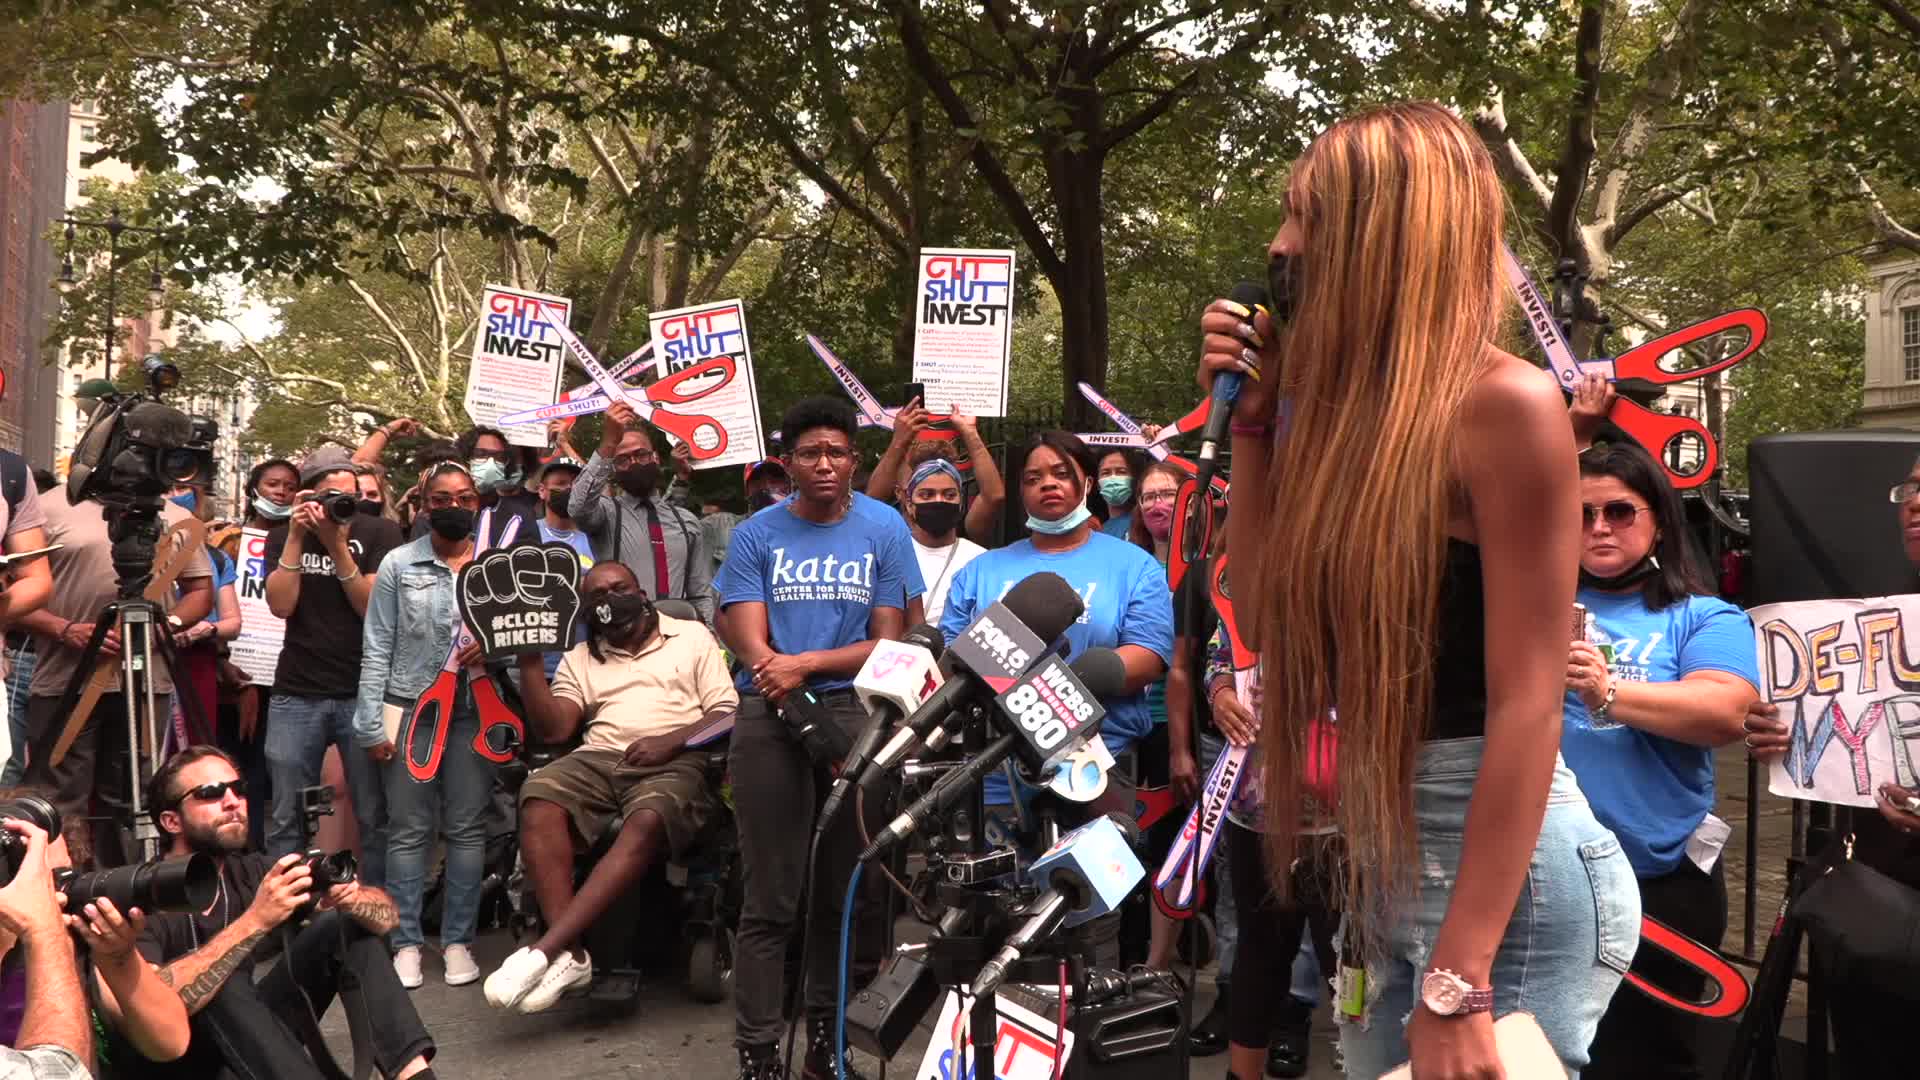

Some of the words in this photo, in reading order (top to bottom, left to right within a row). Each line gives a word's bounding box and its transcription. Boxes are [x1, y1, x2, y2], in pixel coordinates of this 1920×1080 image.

[926, 256, 1009, 280] CUT
[925, 270, 1008, 302] SHUT
[490, 293, 567, 320] CUT
[922, 294, 1008, 326] INVEST
[1517, 281, 1557, 348] INVEST!
[487, 308, 554, 342] SHUT
[660, 307, 738, 340] CUT
[483, 326, 562, 363] INVEST
[570, 340, 606, 382] INVEST!
[663, 328, 742, 361] SHUT
[834, 364, 867, 404] INVEST!
[535, 407, 561, 419] CUT!
[567, 399, 600, 412] SHUT!
[1089, 435, 1130, 445] INVEST!
[771, 547, 874, 588] katal
[772, 585, 812, 596] CENTER
[816, 585, 834, 593] FOR
[816, 592, 835, 601] AND
[491, 611, 559, 630] #CLOSE
[494, 627, 558, 648] RIKERS
[972, 616, 1018, 660] FOX
[1008, 648, 1031, 669] 5
[1040, 662, 1095, 722] WCBS
[1005, 683, 1068, 750] 880
[1201, 759, 1239, 836] INVEST!
